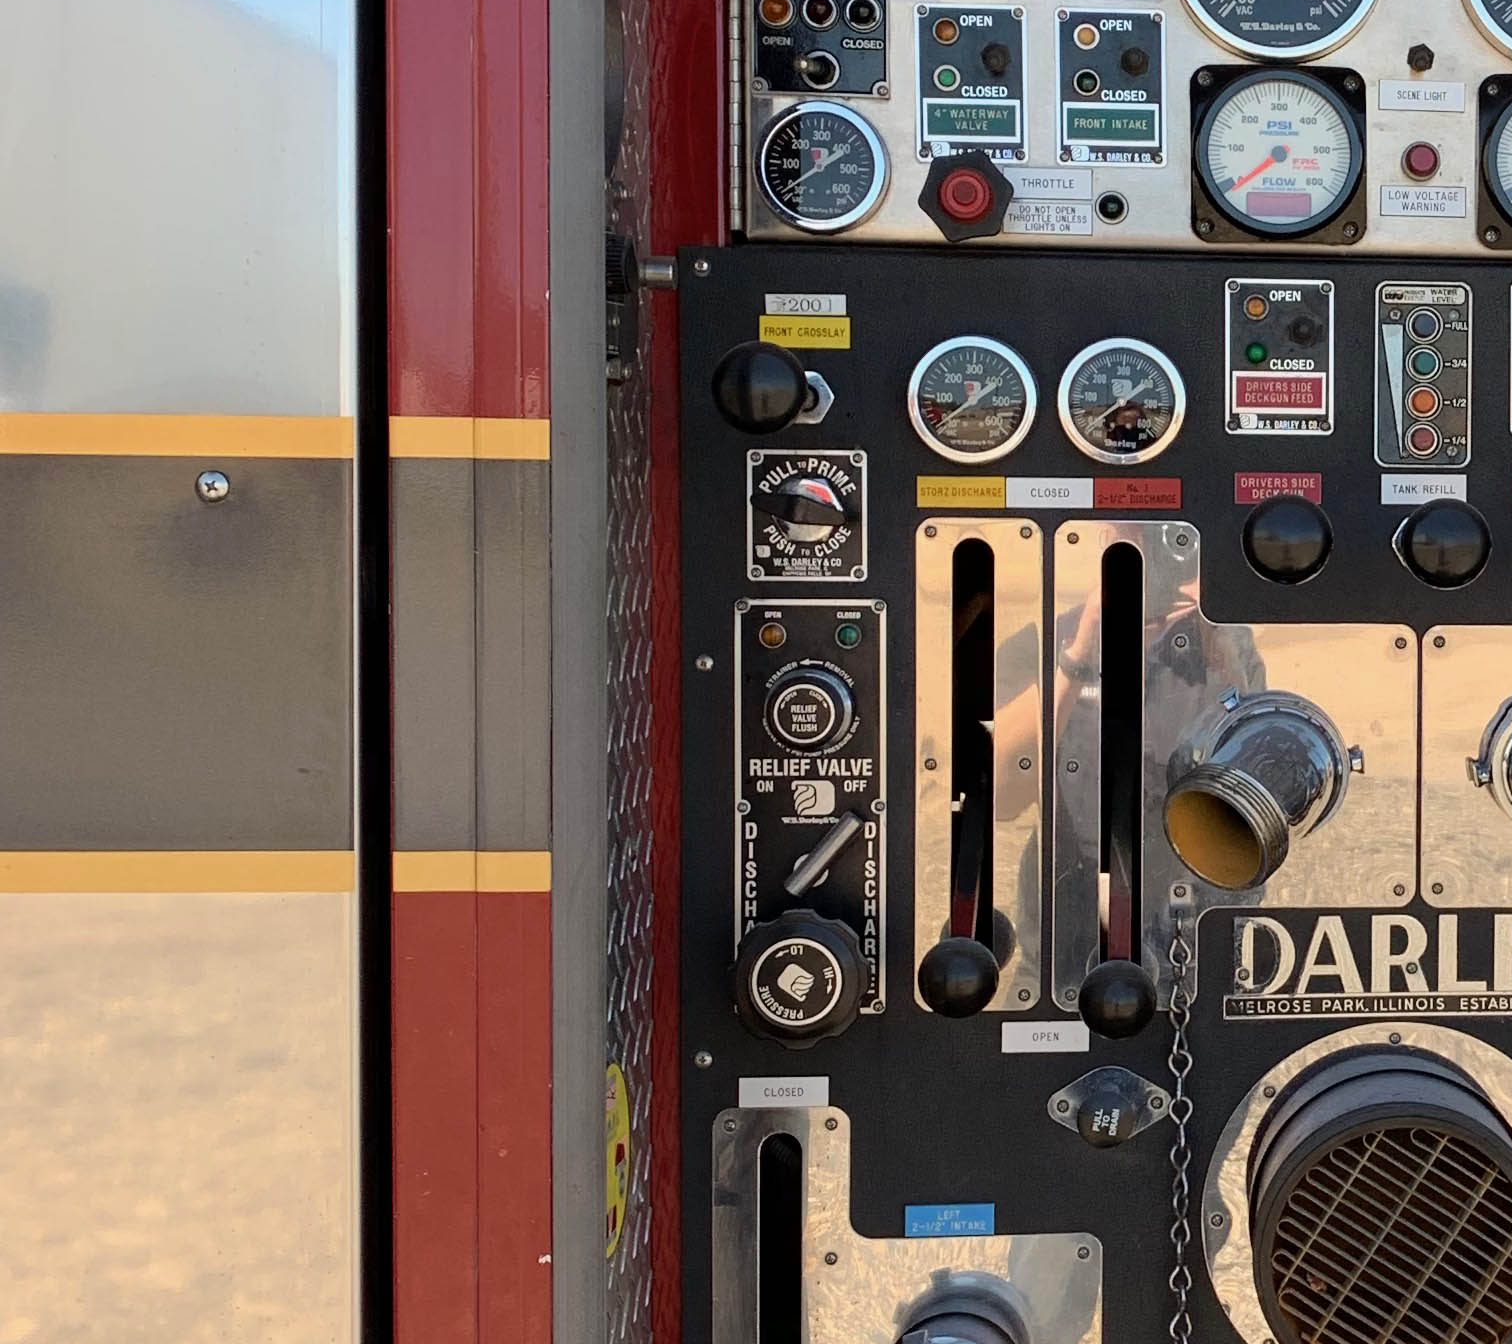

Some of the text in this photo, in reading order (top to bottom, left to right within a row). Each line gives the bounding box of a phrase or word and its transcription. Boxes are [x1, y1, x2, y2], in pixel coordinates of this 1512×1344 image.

[959, 14, 993, 27] OPEN
[1100, 19, 1133, 32] OPEN
[762, 35, 791, 46] OPEN
[842, 39, 884, 50] CLOSED
[961, 85, 1008, 98] CLOSED
[1101, 89, 1148, 102] CLOSED
[1396, 90, 1448, 102] SCENE LIGHT
[954, 119, 989, 131] VALVE
[1074, 117, 1149, 131] FRONT INTAKE
[1021, 177, 1075, 189] THROTTLE
[1388, 190, 1460, 202] LOW VOLTAGE
[1401, 201, 1447, 213] WARNING
[1269, 290, 1302, 302] OPEN
[1430, 288, 1458, 296] WATER
[1432, 295, 1457, 303] LEVEL
[764, 326, 846, 338] FRONT CROSSLAY
[1451, 321, 1468, 331] FULL
[1269, 359, 1315, 371] CLOSED
[1451, 359, 1468, 368] 3/4
[1246, 381, 1313, 393] DRIVERS SIDE
[1245, 393, 1314, 404] DECKGUN FEED
[1451, 398, 1467, 407] 1/2
[1451, 436, 1467, 446] 1/4
[758, 457, 857, 496] PULL TO PRIME
[1240, 477, 1316, 489] DRIVERS SIDE
[920, 487, 1003, 498] STORZ DISCHARGE
[1030, 487, 1071, 499] CLOSED
[1392, 484, 1457, 495] TANK REFILL
[763, 524, 853, 558] PUSH TO CLOSE
[765, 660, 856, 690] STRAINER REMOVAL
[790, 704, 818, 714] RELIEF
[791, 714, 818, 724] VALVE
[791, 723, 819, 733] FLUSH
[749, 758, 874, 778] RELIEF VALVE
[756, 780, 775, 793] ON
[843, 779, 868, 793] OFF
[758, 985, 805, 1020] PRESSURE
[1373, 997, 1446, 1012] ILLINOIS
[1032, 1032, 1060, 1042] OPEN
[763, 1085, 805, 1099] CLOSED
